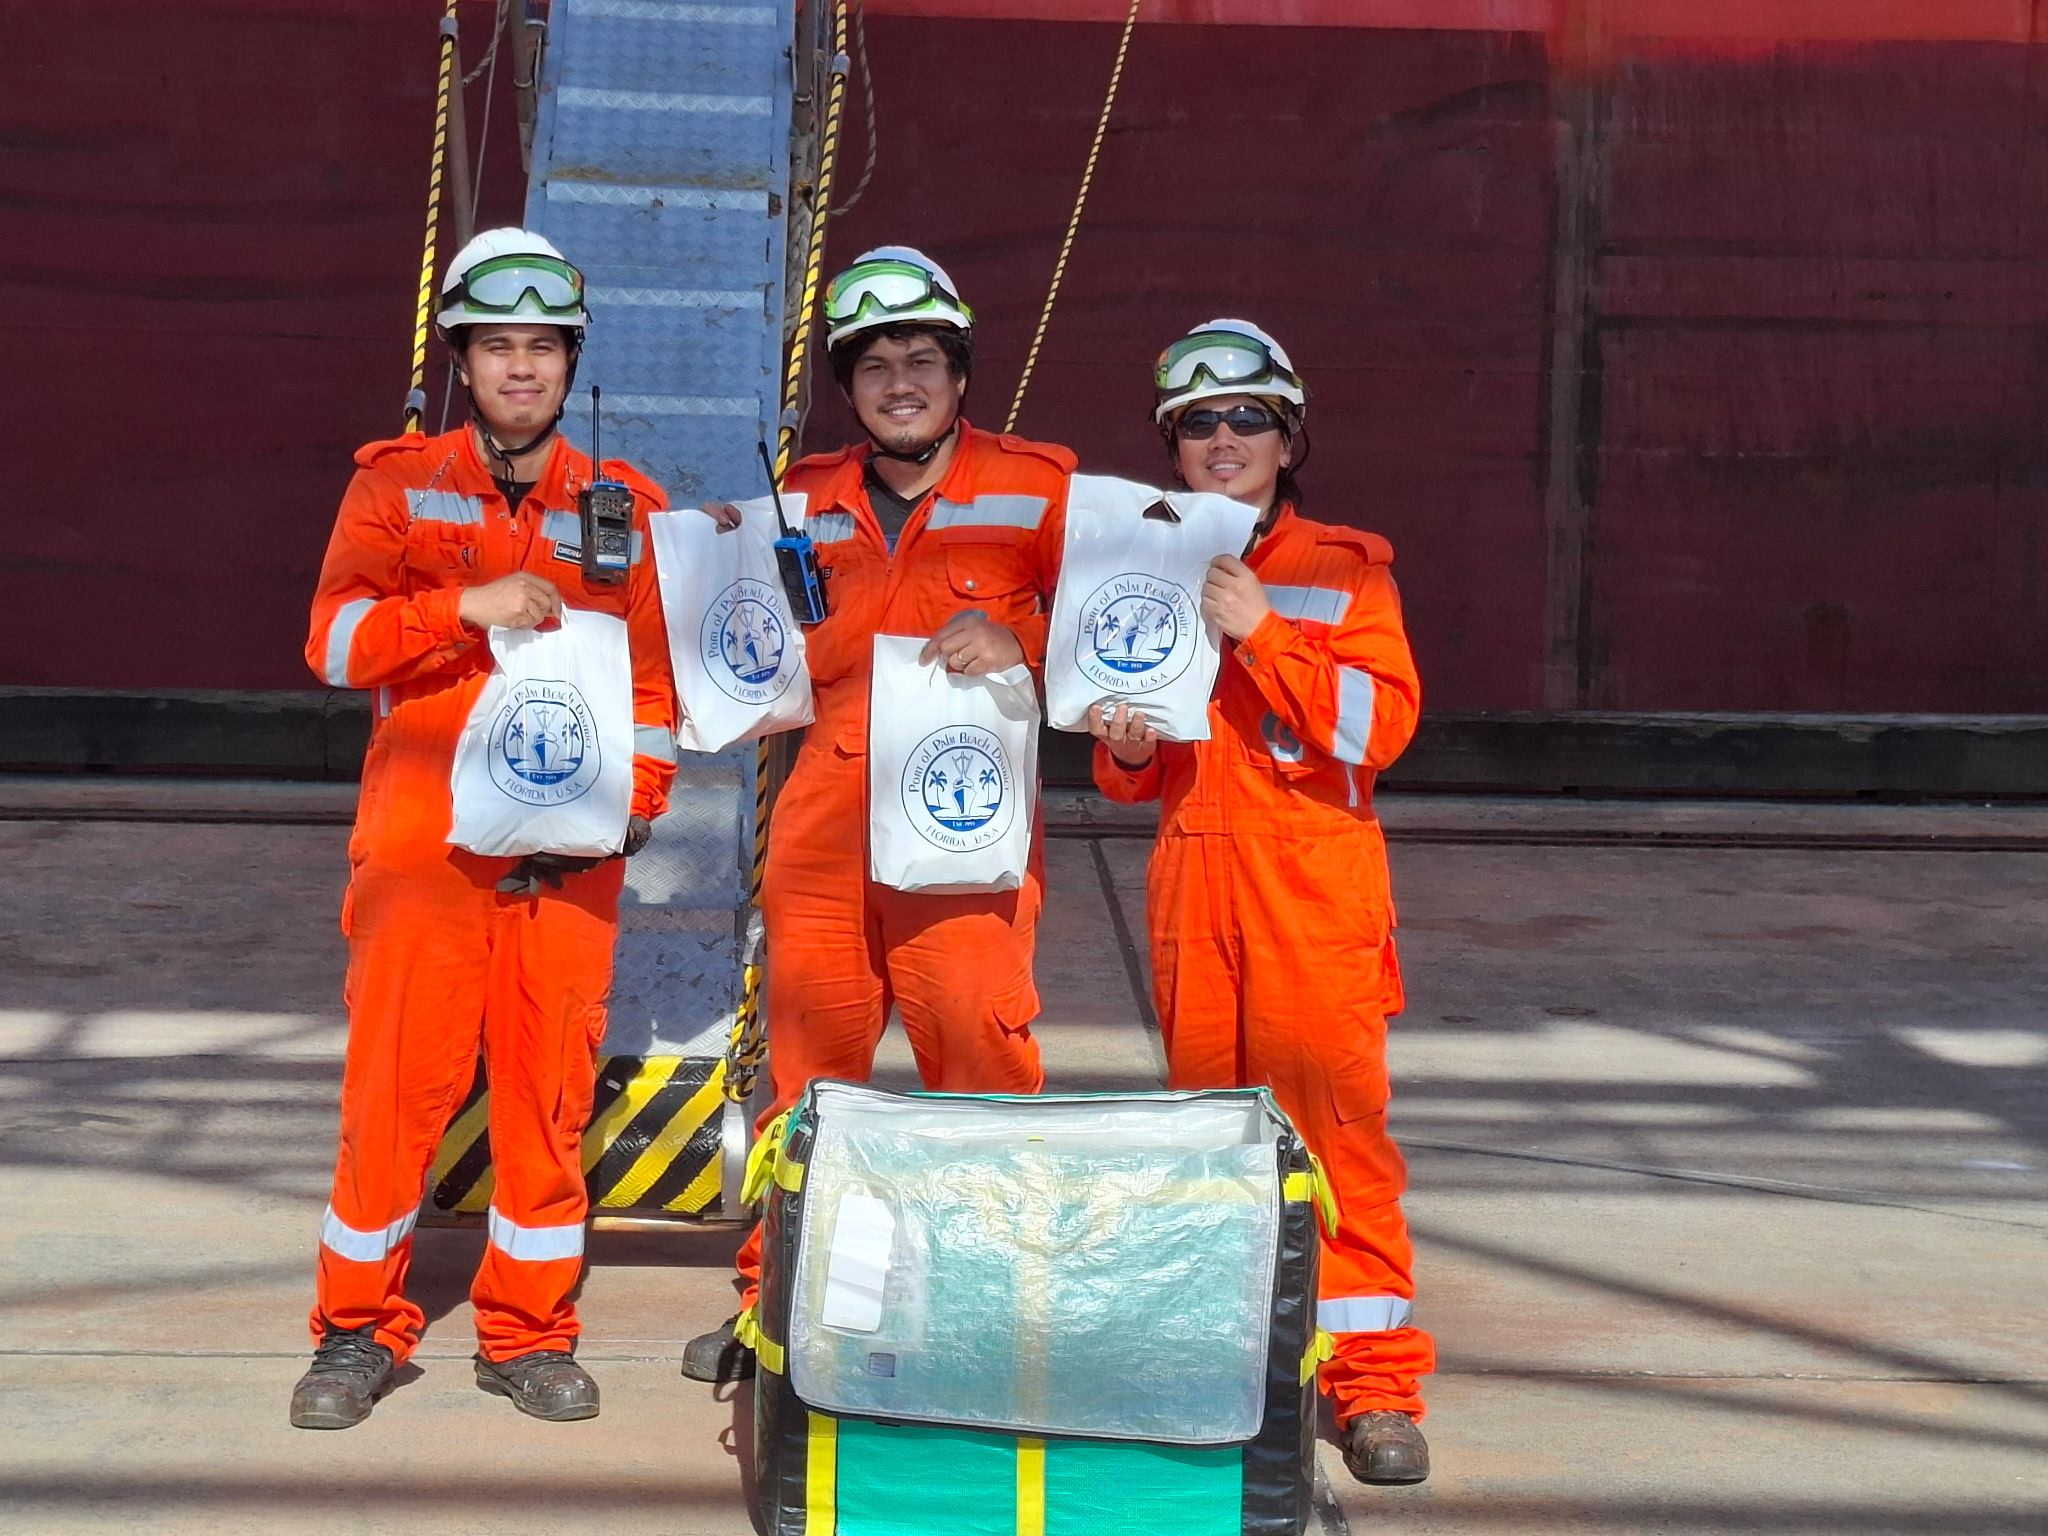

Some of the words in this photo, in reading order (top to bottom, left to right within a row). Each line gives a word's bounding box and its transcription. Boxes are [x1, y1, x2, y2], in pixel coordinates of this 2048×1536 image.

[1088, 665, 1130, 688] FLORIDA
[504, 778, 547, 800] FLORIDA
[925, 824, 966, 847] FLORIDA
